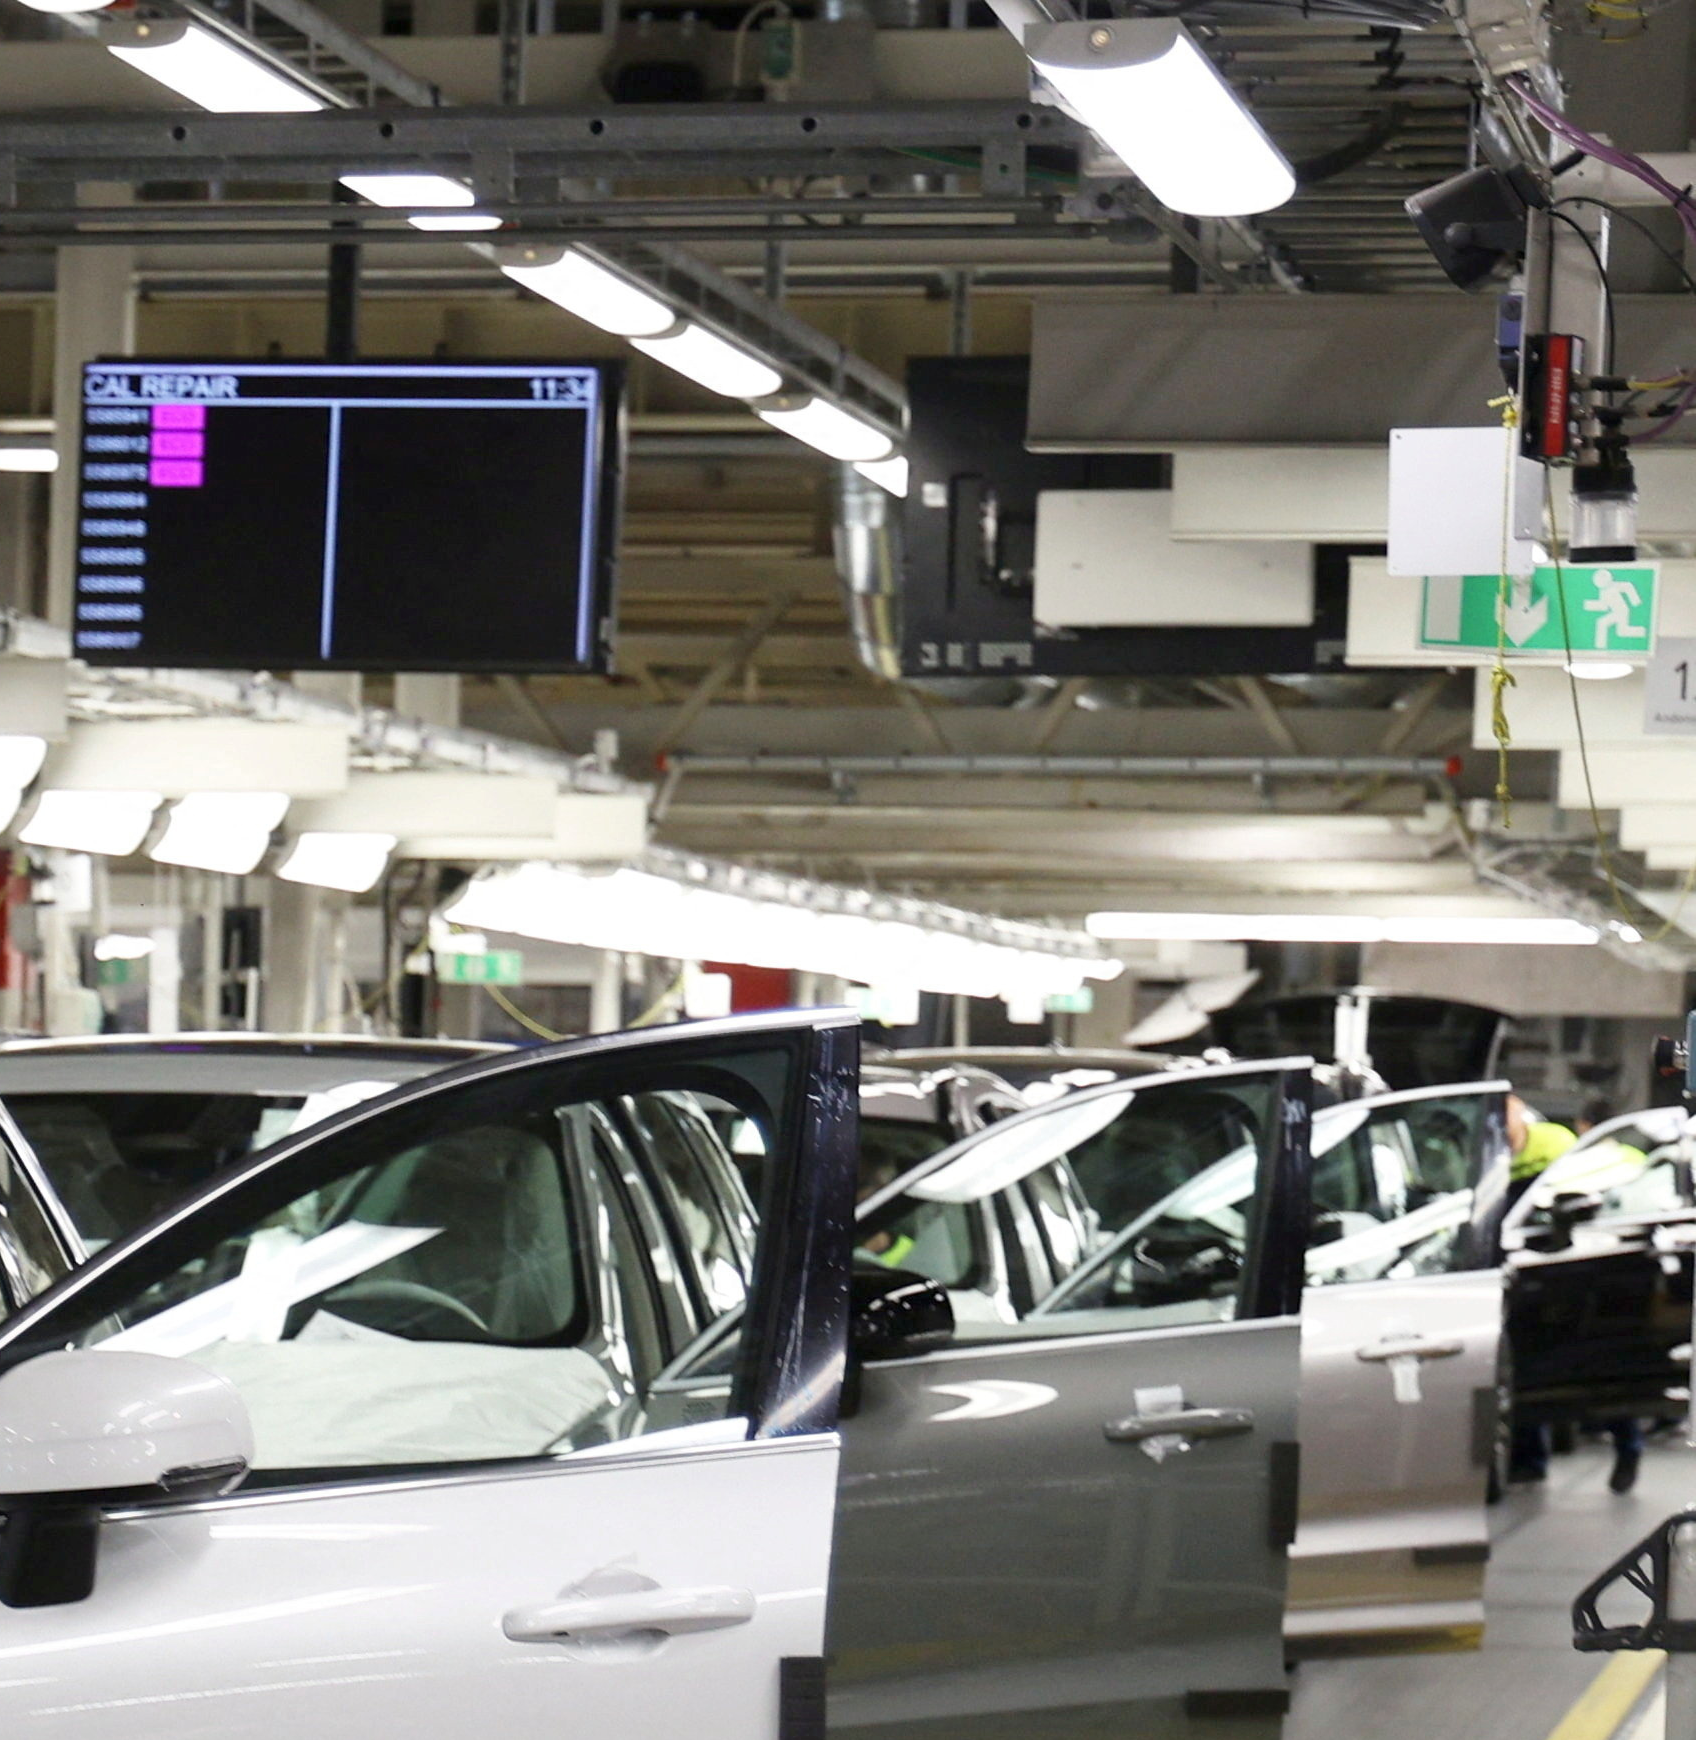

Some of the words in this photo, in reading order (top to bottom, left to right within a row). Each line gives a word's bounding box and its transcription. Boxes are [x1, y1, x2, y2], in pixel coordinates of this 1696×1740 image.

[84, 374, 136, 398] CAL
[140, 375, 239, 399] REPAIR
[1674, 660, 1696, 702] 1
